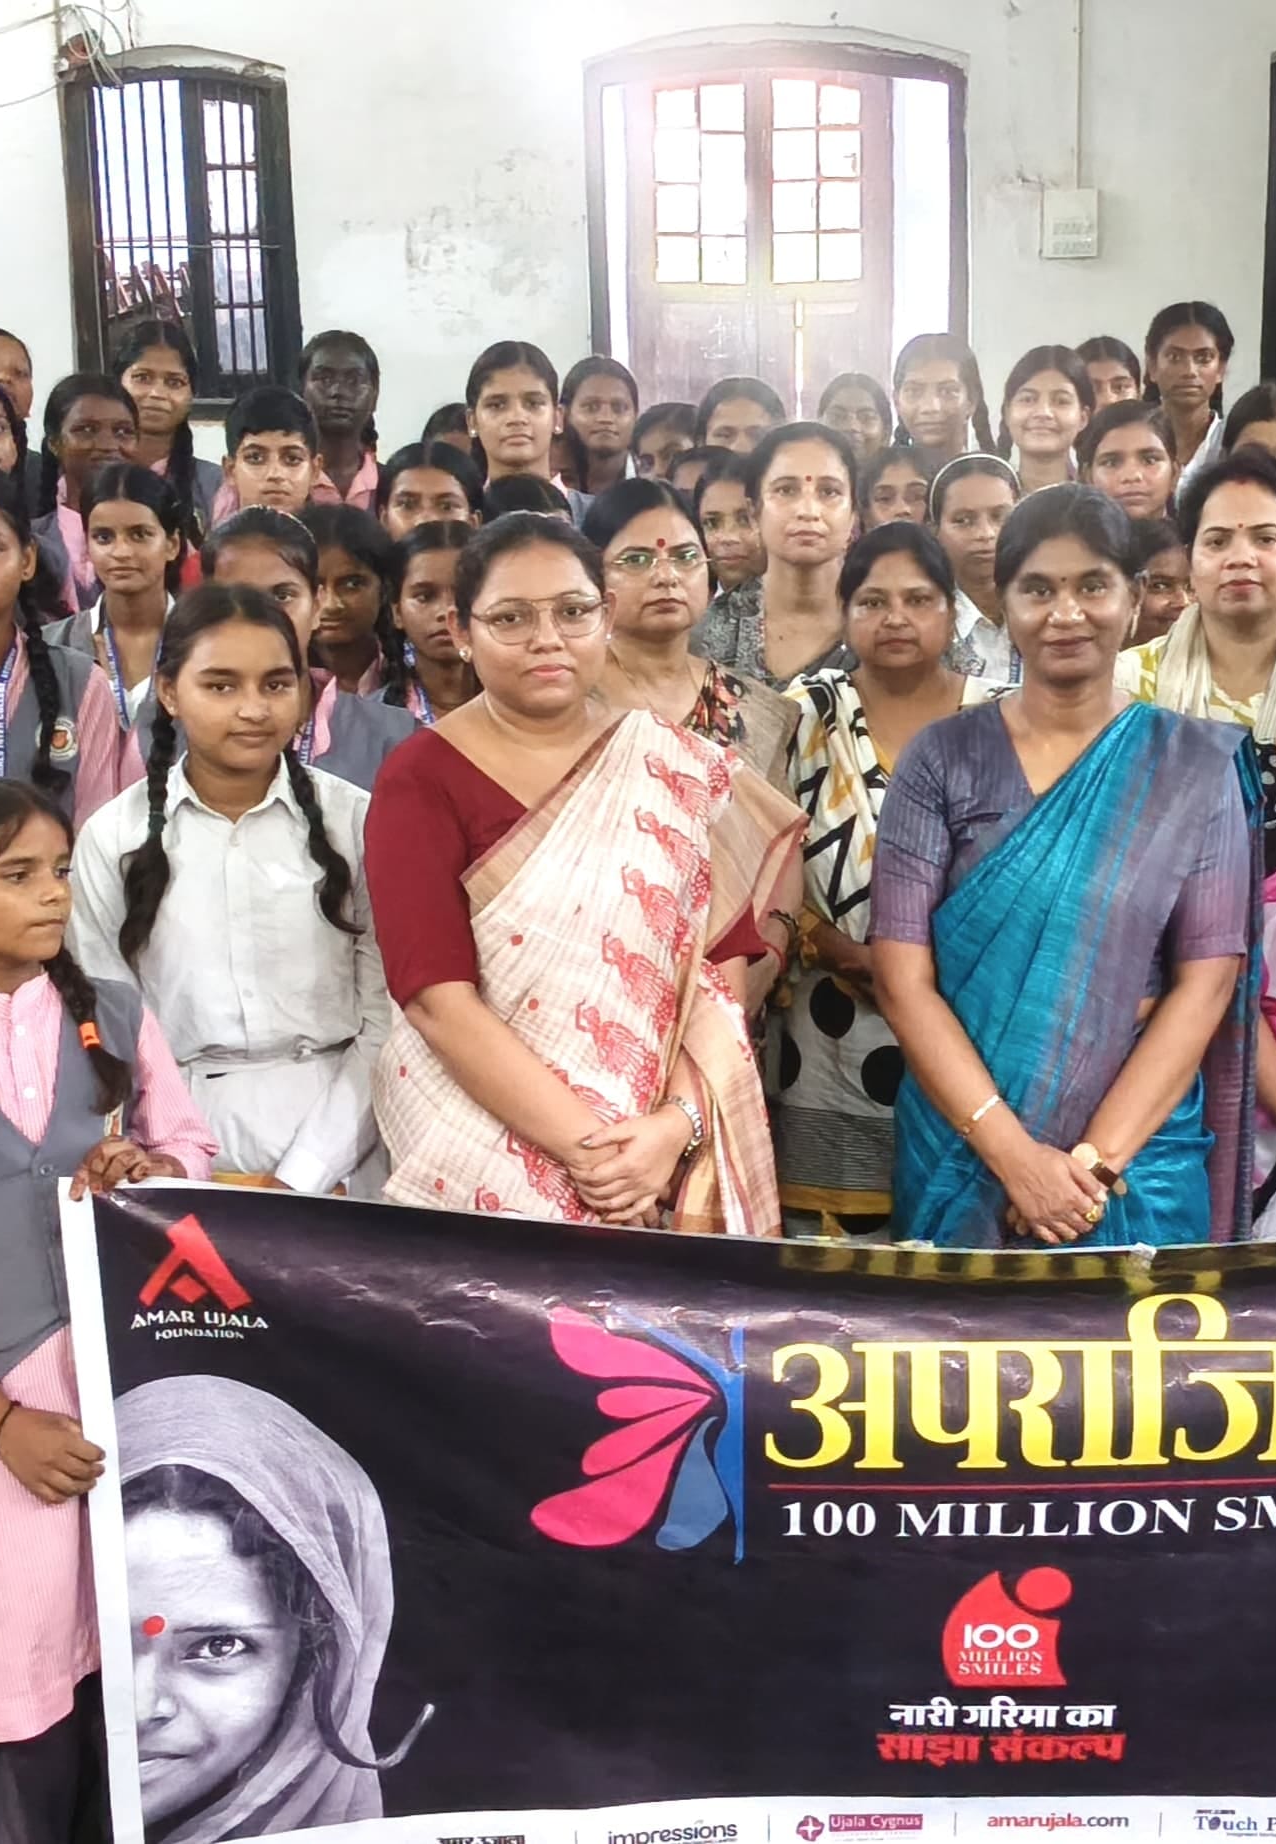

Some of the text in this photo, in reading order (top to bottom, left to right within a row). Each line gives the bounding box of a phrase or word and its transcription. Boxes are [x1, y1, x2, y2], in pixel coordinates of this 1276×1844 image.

[130, 1310, 269, 1330] AMAR UJALA
[154, 1327, 245, 1341] FOUNDATION
[781, 1501, 876, 1538] 100
[897, 1499, 1195, 1538] MILLION
[963, 1623, 1040, 1650] 100
[958, 1651, 1044, 1662] MILLION
[958, 1662, 1043, 1676] SMILES
[889, 1695, 1118, 1728] नारी गरिमा का
[876, 1728, 1127, 1768] साझा संकल्प
[830, 1815, 921, 1830] Ujala Cygnus
[987, 1812, 1130, 1832] amarujala.com
[607, 1822, 739, 1844] impressions
